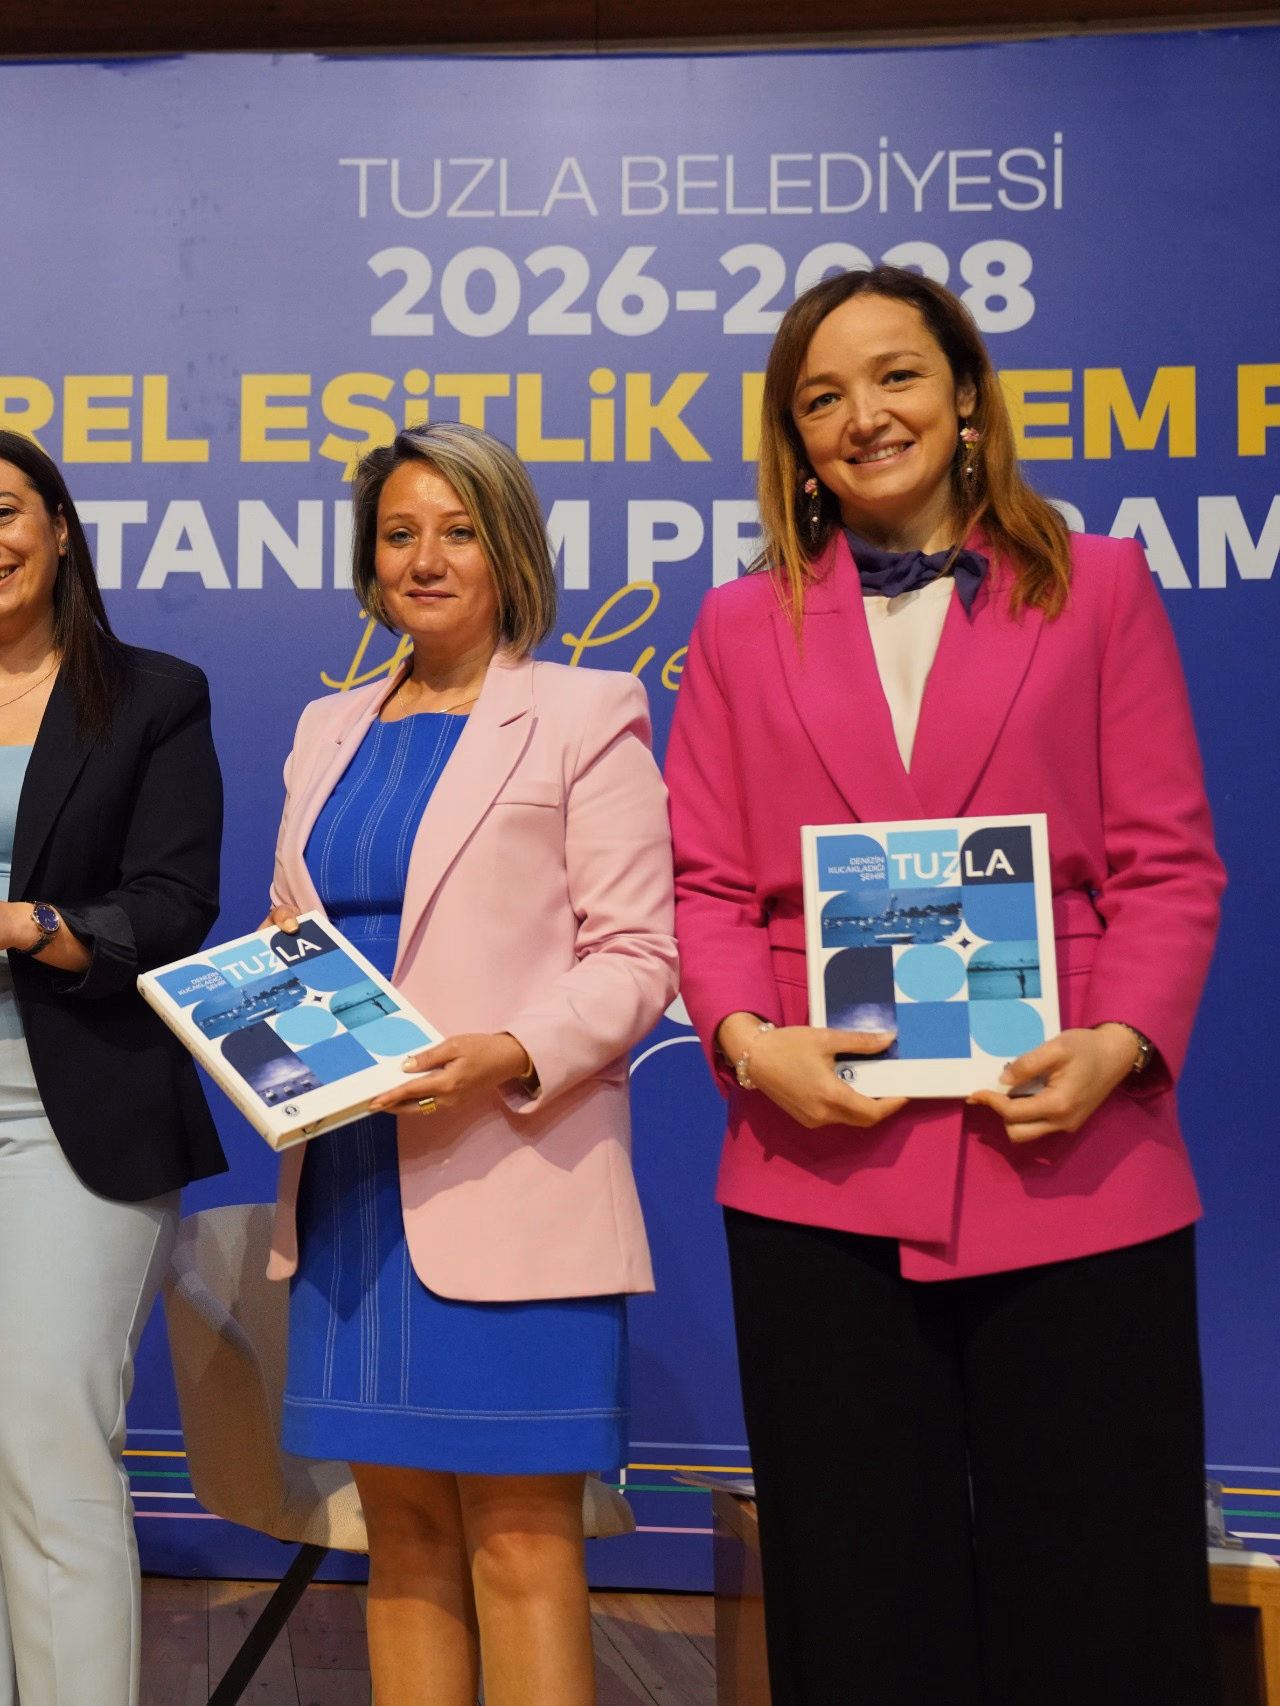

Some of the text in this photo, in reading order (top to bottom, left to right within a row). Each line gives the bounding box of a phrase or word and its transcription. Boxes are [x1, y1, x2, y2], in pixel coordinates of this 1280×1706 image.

[338, 131, 1064, 219] TUZLA BELEDİYESİ
[366, 239, 1036, 337] 2026-28
[890, 848, 1016, 881] TUZLA
[221, 937, 323, 981] TUZLA
